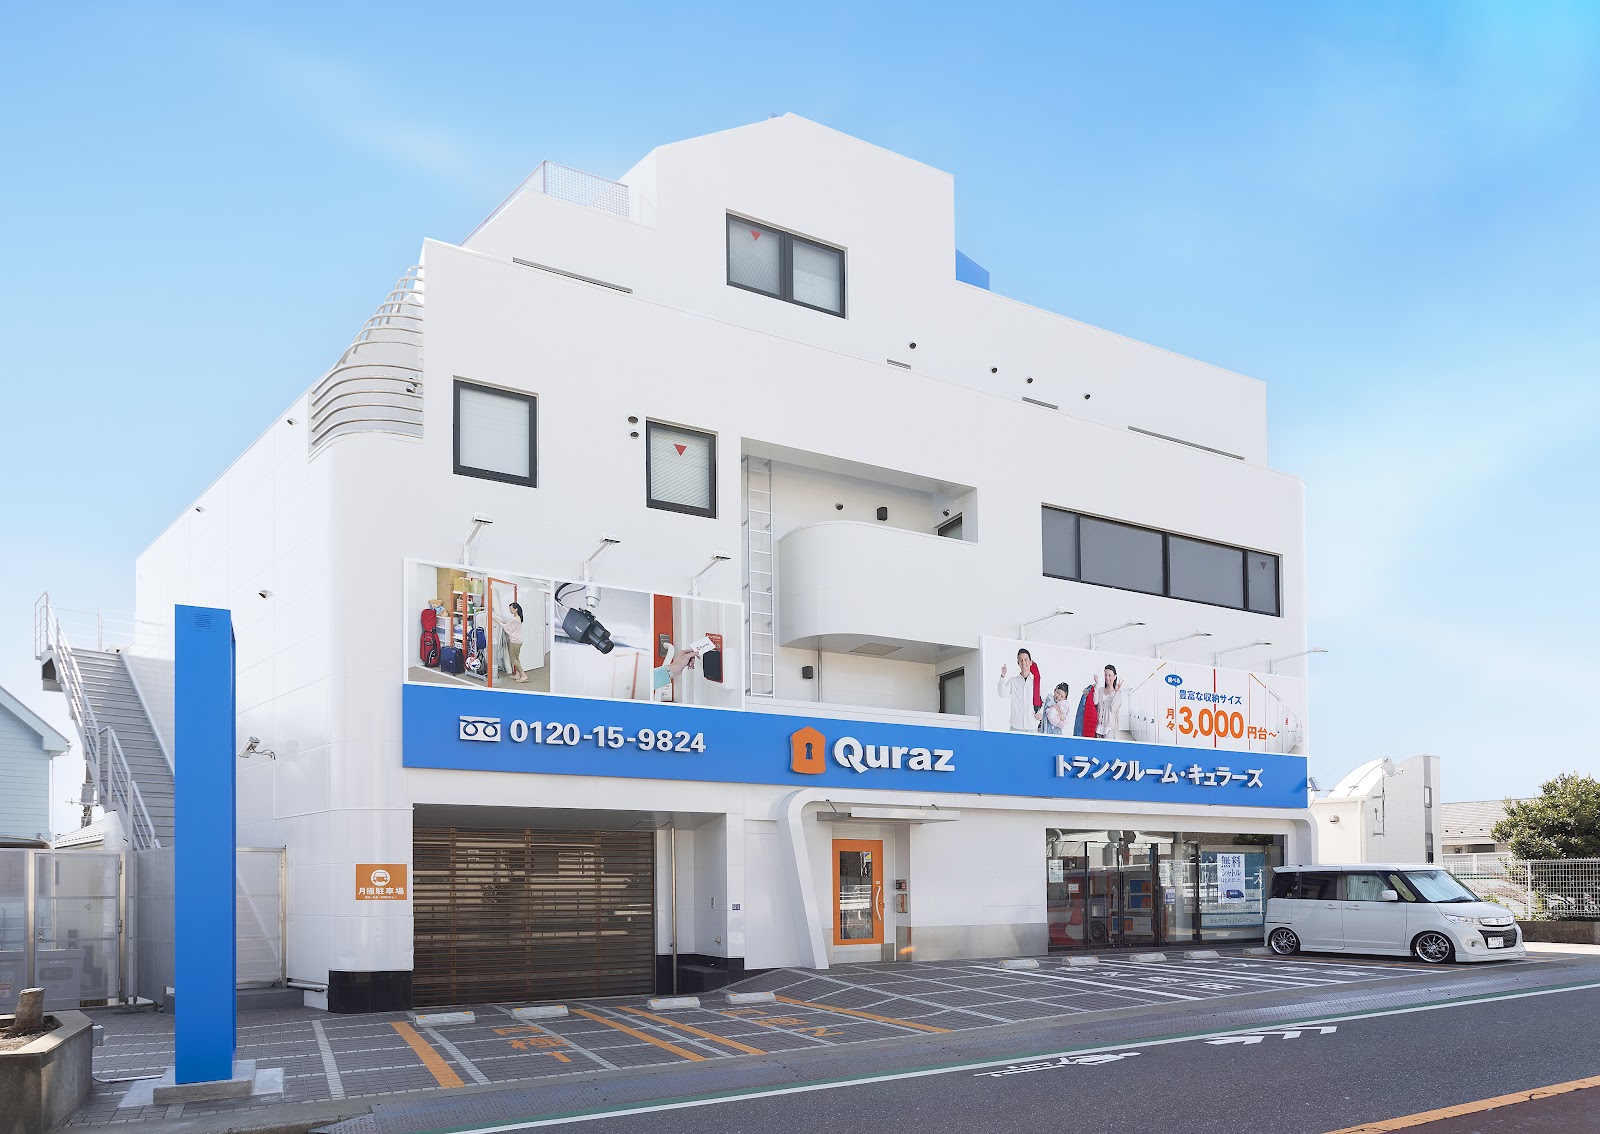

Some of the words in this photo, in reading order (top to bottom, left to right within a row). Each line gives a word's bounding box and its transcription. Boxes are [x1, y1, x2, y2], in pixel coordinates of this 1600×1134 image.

[1179, 689, 1242, 705] 豊富な収納サイズ
[510, 719, 707, 753] 0120-15-9824
[833, 736, 956, 774] Quraz
[1056, 754, 1264, 788] トランクルーム・キュラーズ
[1221, 855, 1241, 868] 無料
[1221, 868, 1242, 877] シャトル
[358, 887, 405, 895] 月極駐車場
